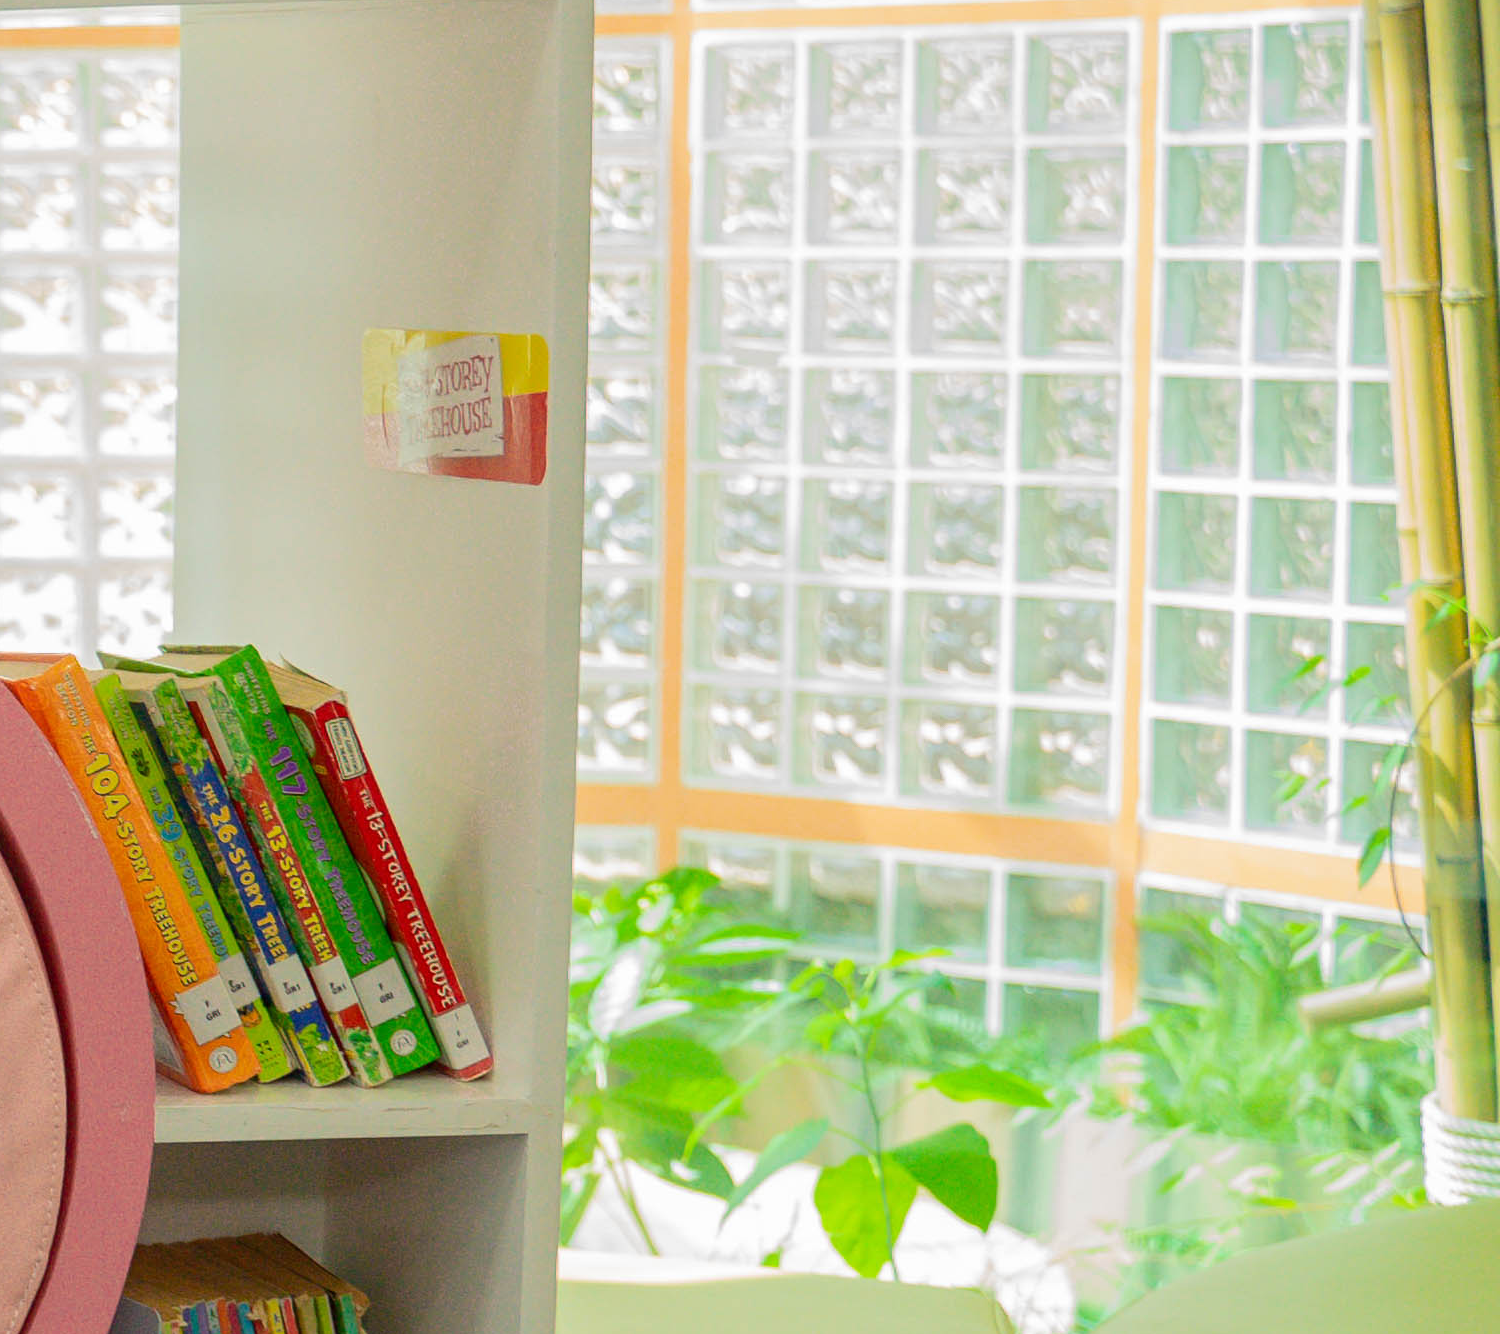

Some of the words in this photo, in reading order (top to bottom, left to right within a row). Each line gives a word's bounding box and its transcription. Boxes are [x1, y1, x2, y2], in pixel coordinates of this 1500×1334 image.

[82, 732, 96, 753] THE
[86, 753, 155, 882] 104-STORY
[202, 782, 216, 807] THE
[210, 809, 266, 908] 26-STORY
[259, 801, 273, 822] THE
[266, 823, 313, 910] 13-STORY
[269, 747, 331, 863] 117-STORY
[326, 867, 375, 965] TREEHOUSE
[144, 884, 198, 987] TREEHOUSE
[359, 789, 372, 810] THE
[367, 812, 413, 902] 13-STOREY
[407, 907, 456, 1008] TREEHOUSE
